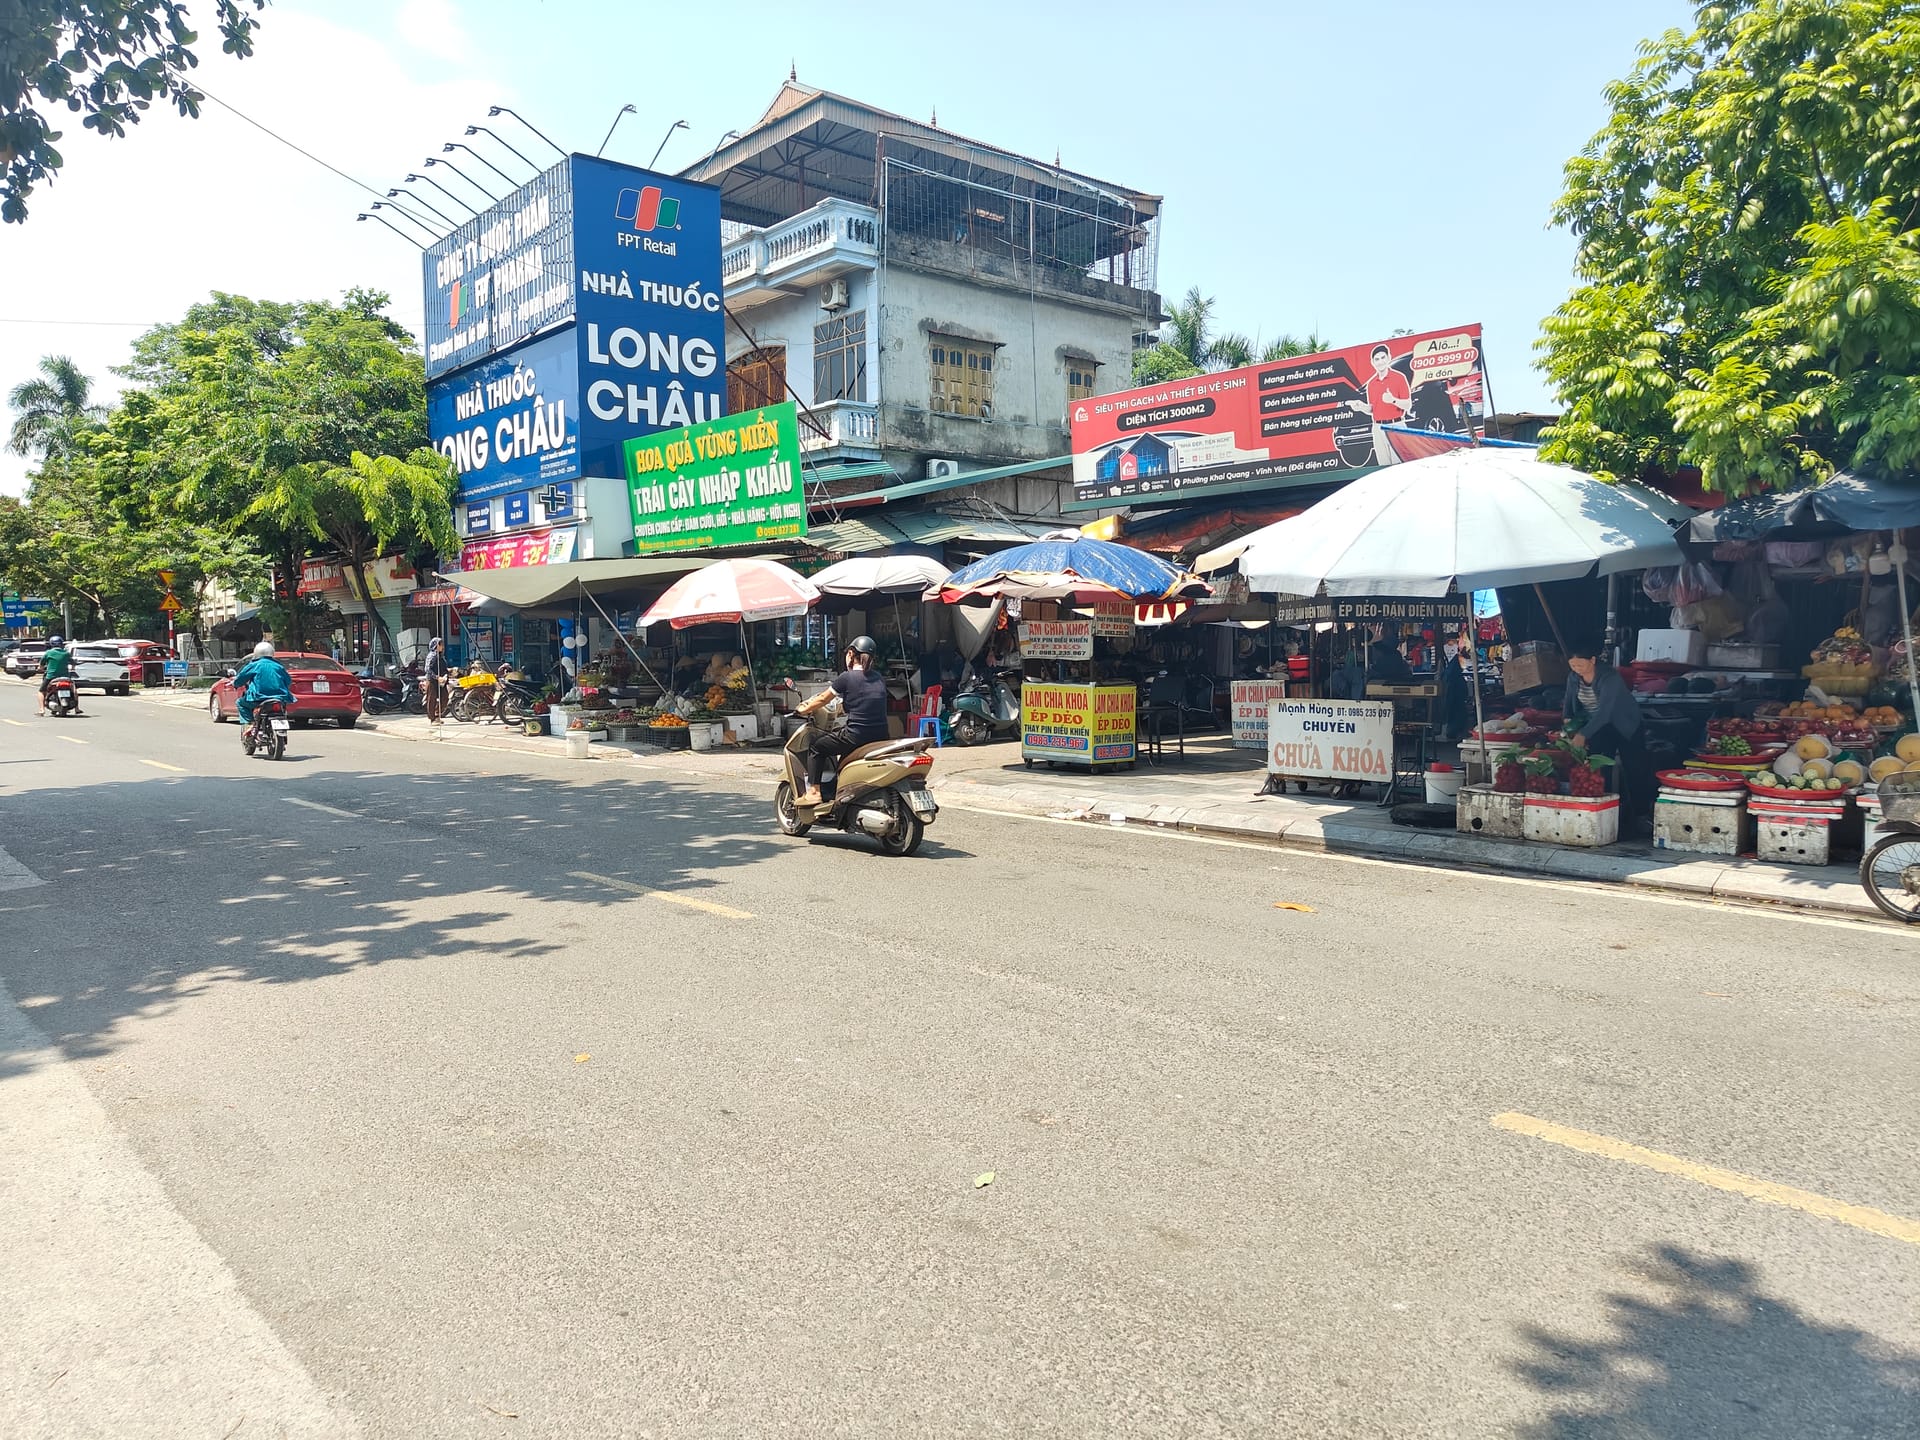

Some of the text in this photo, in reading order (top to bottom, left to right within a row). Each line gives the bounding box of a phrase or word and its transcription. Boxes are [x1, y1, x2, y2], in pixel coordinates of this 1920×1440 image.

[617, 232, 677, 257] FPT Retail
[493, 246, 544, 299] PHARMA
[582, 270, 720, 312] NHÀ THUỐC
[587, 322, 717, 377] LONG
[1413, 350, 1475, 369] 1900 9999 01
[1263, 374, 1285, 384] Mang
[1286, 371, 1304, 380] mẫu
[1305, 368, 1319, 378] tận
[1435, 368, 1453, 378] đón
[456, 359, 536, 421] NHÀ THUỐC
[1095, 377, 1247, 415] SIÊU THỊ GẠCH VÀ THIẾT BỊ VỆ SINH
[1264, 388, 1337, 408] Đón khách tận nhà
[587, 379, 720, 427] CHÂU
[1125, 403, 1206, 427] DIỆN TÍCH 3000M2
[1263, 410, 1354, 431] Bán hàng tại công trình
[495, 395, 565, 463] CHÂU
[635, 411, 779, 474] HOA QUẢ VÙNG MIỀN
[633, 449, 793, 515] TRÁI CÂY NHẬP KHẨU
[1182, 475, 1209, 486] Phường
[1209, 473, 1225, 483] Khai
[1226, 470, 1250, 482] Quang
[1255, 467, 1273, 476] Vĩnh
[1273, 465, 1287, 474] Yên
[1288, 461, 1304, 473] (Đối
[1305, 459, 1322, 470] diện
[1323, 458, 1339, 468] GO)
[635, 522, 656, 537] CHUYÊN
[656, 519, 671, 534] CUNG
[732, 508, 746, 525] NHÀ
[747, 506, 766, 523] HÀNG
[770, 503, 782, 523] HỘI
[1338, 600, 1353, 617] ÉP
[1408, 601, 1434, 620] ĐIỆN
[1025, 687, 1042, 708] LÀM
[1044, 688, 1063, 709] CHÌA
[1232, 684, 1247, 703] LÀM
[1248, 683, 1264, 703] CHÌA
[1030, 709, 1083, 725] ÉP DẺO
[1239, 705, 1254, 718] ÉP
[1278, 702, 1306, 716] Mạnh
[1308, 702, 1334, 718] Hùng
[1348, 707, 1364, 717] 0985
[1365, 707, 1377, 718] 235
[1024, 724, 1090, 737] THAY PIN ĐIỀU KHIỂN
[1097, 714, 1131, 731] ÉP DẺO
[1303, 719, 1356, 734] CHUYÊN
[1273, 735, 1388, 775] CHỮA KHÓA
